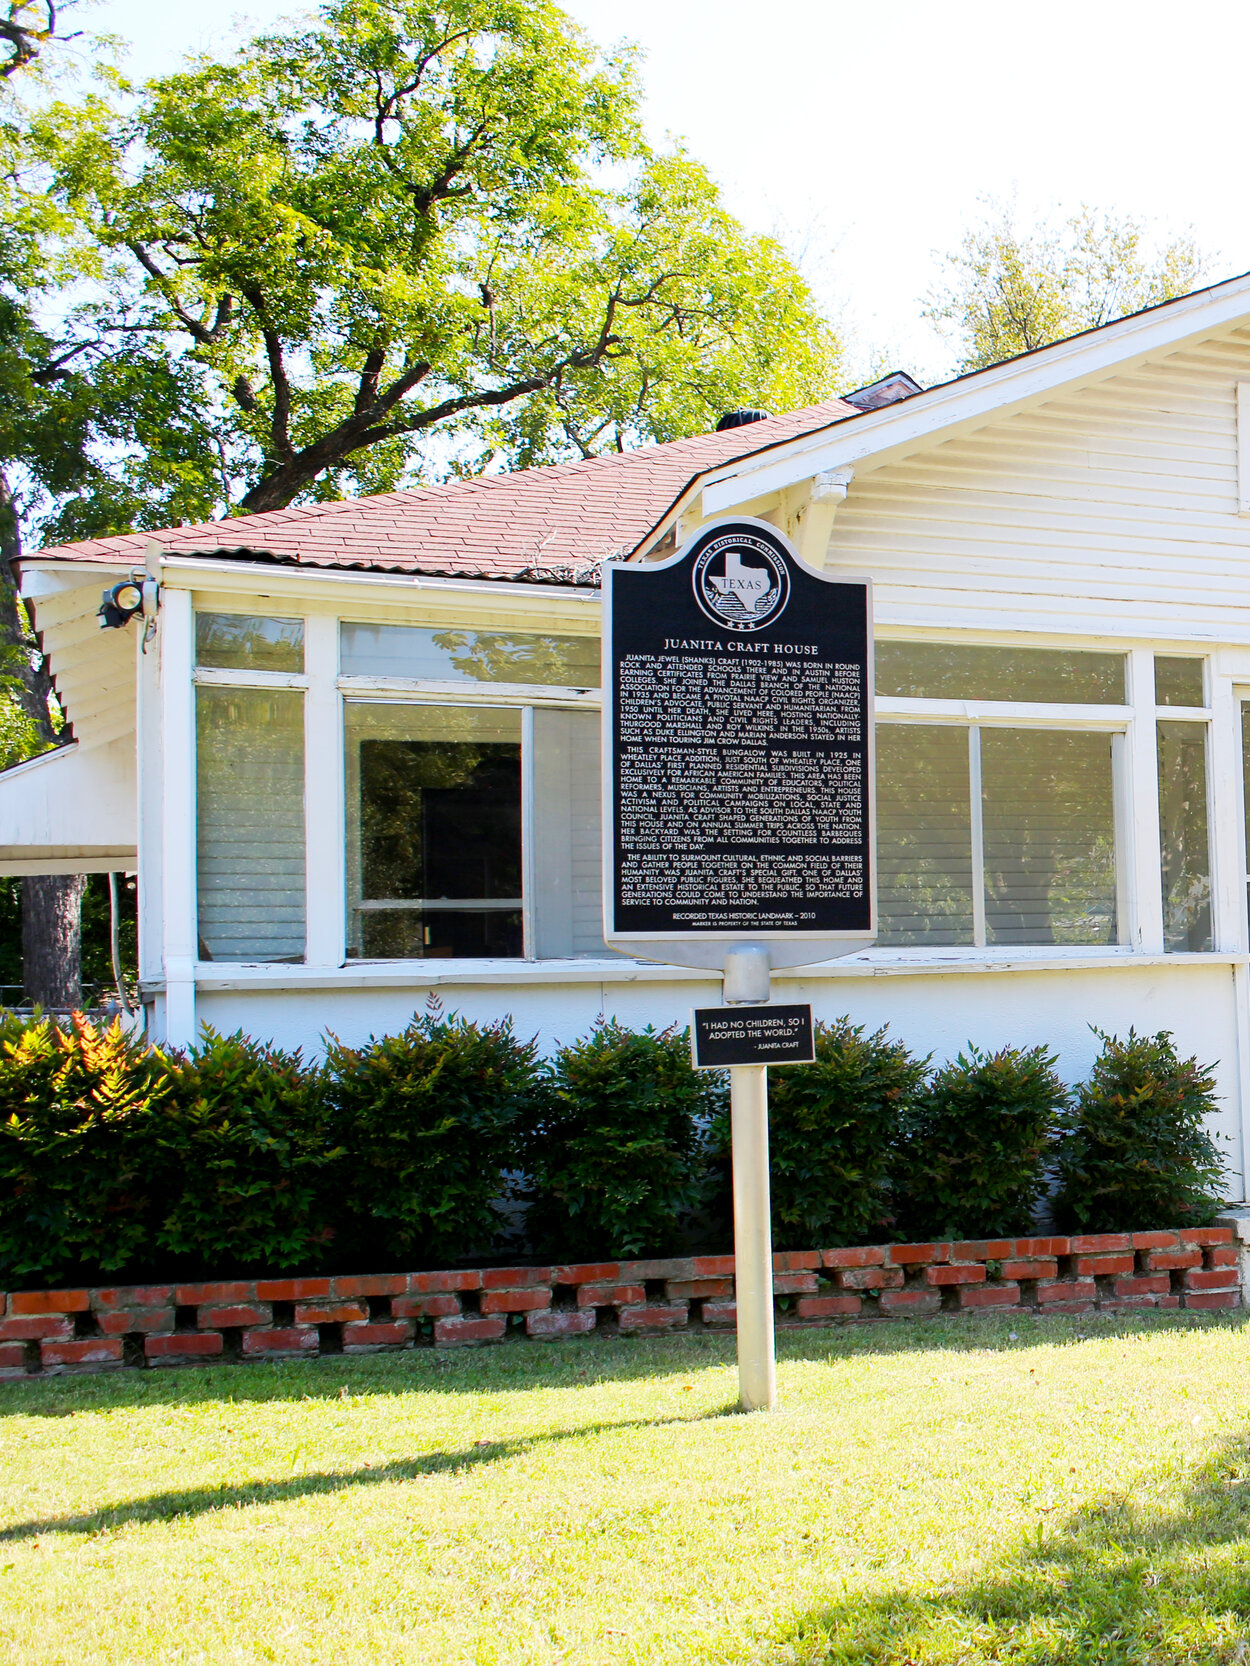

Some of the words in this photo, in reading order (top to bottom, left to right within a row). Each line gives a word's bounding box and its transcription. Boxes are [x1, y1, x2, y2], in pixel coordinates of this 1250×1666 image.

[698, 549, 713, 569] TEXAS
[713, 538, 752, 549] HISTORICAL
[757, 543, 785, 575] COMMISSION
[722, 579, 761, 590] TEXAS
[664, 639, 723, 651] JUANITA
[728, 641, 771, 652] CRAFT
[774, 644, 818, 655] HOUSE
[625, 654, 656, 662] JUANITA
[682, 657, 716, 665] (SHANKS)
[741, 659, 783, 667] (1902-1985)
[667, 663, 703, 672] ATTENDED
[657, 670, 704, 679] CERTIFICATES
[620, 684, 669, 692] ASSOCIATION
[703, 687, 757, 695] ADVANCEMENT
[649, 747, 717, 755] CRAFTSMAN-STYLE
[746, 1019, 786, 1028] CHILDREN,
[709, 1030, 745, 1039] ADOPTED
